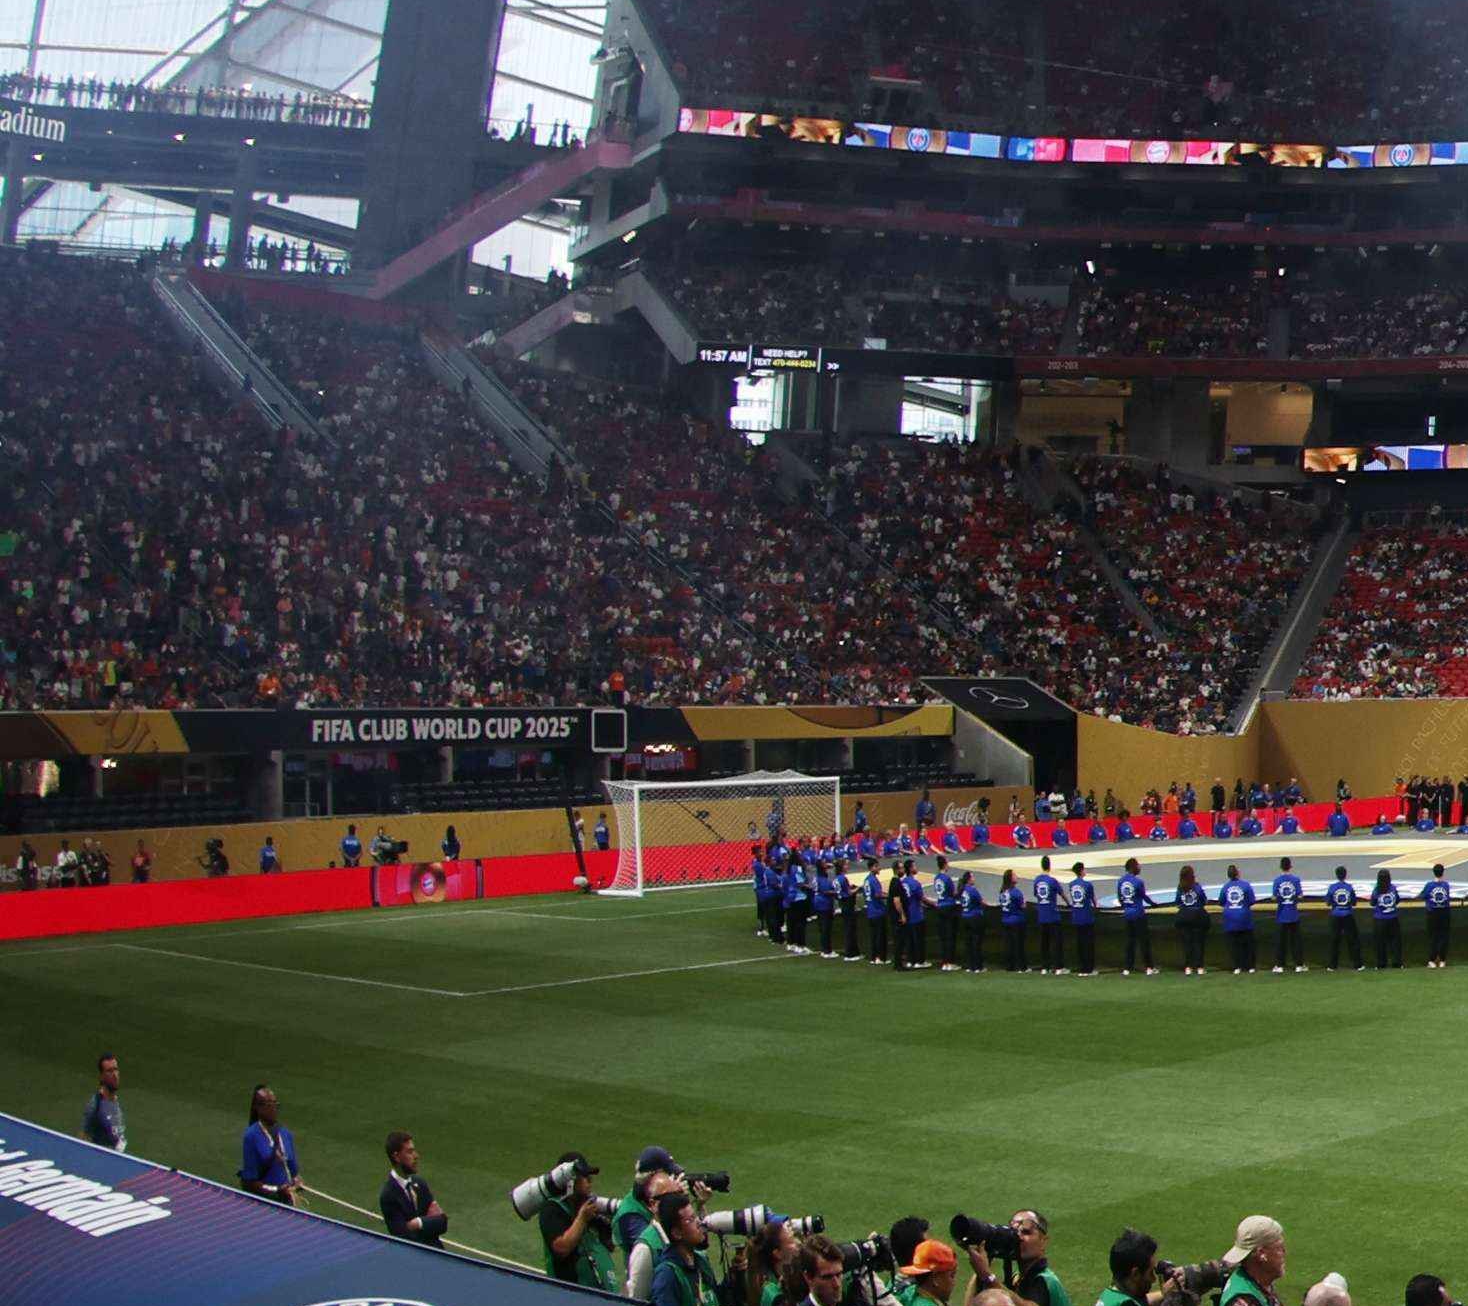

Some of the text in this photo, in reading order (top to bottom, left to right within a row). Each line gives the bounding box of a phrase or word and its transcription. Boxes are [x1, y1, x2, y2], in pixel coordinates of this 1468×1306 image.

[700, 350, 747, 363] 11:57 AM
[312, 718, 355, 741] FIFA
[358, 718, 408, 741] CLUB
[411, 717, 481, 740] WORLD
[485, 717, 522, 739] CUP
